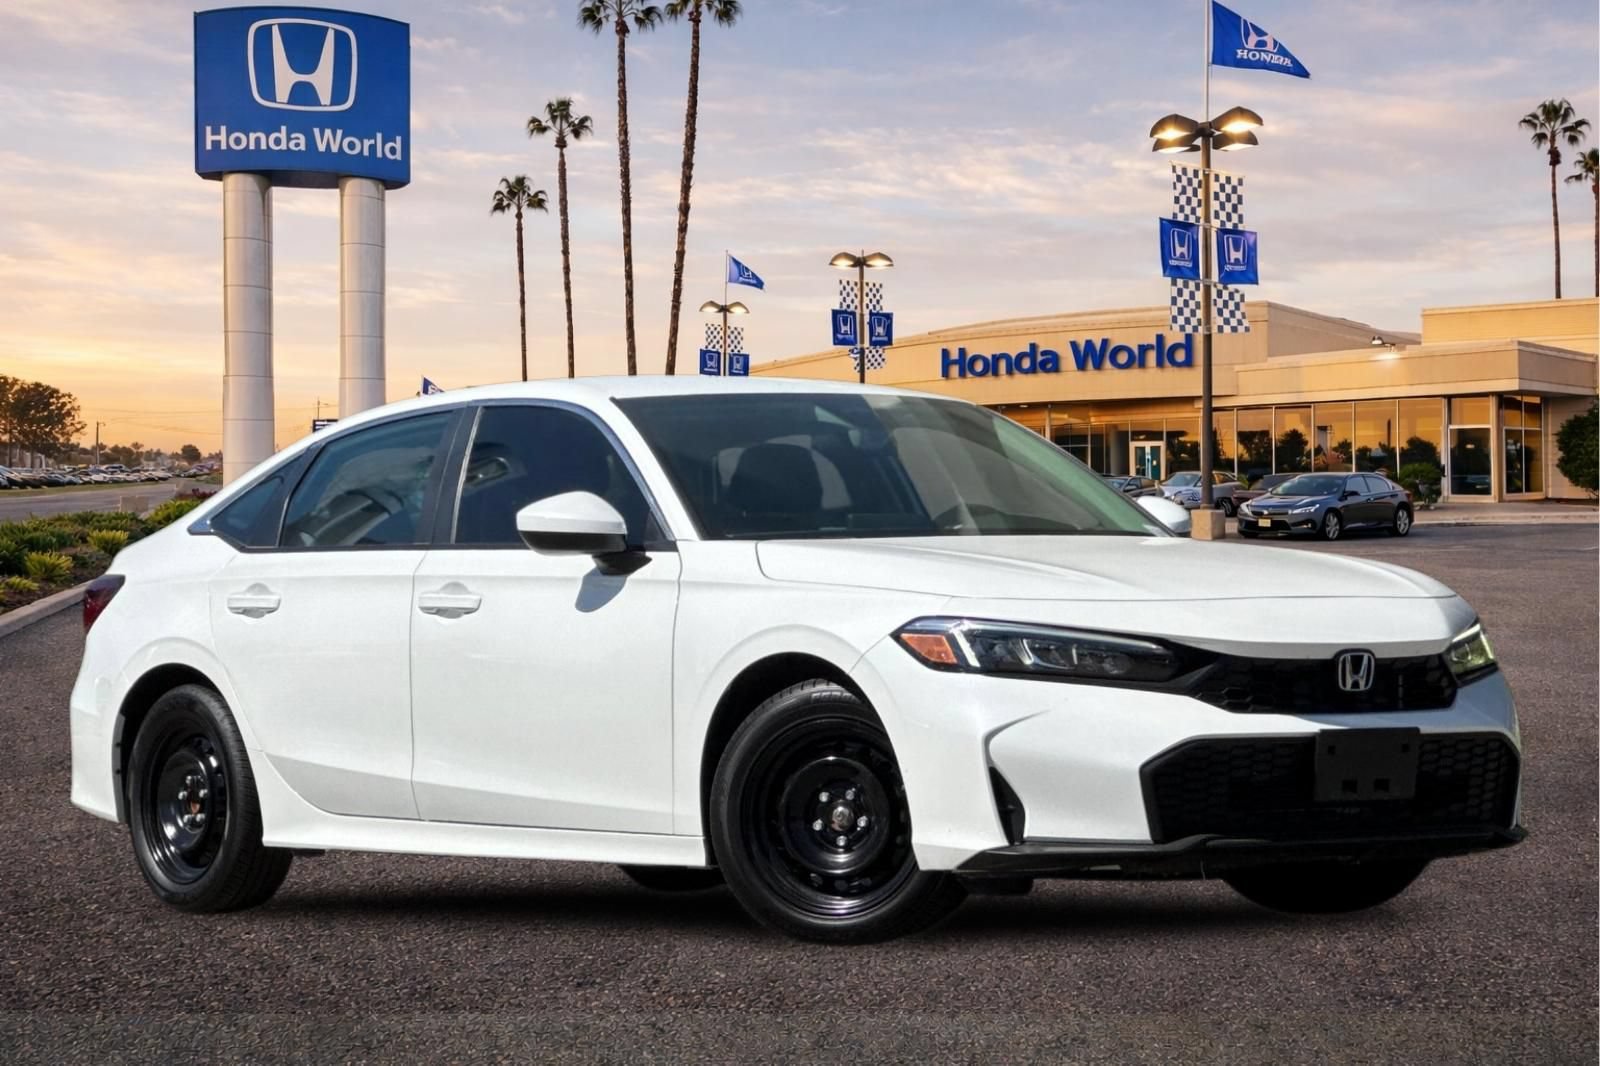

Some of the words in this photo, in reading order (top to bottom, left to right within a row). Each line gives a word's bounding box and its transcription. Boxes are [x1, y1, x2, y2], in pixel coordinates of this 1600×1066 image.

[205, 125, 306, 151] Honda
[313, 127, 402, 161] World
[941, 342, 1060, 378] Honda
[1069, 333, 1194, 371] World
